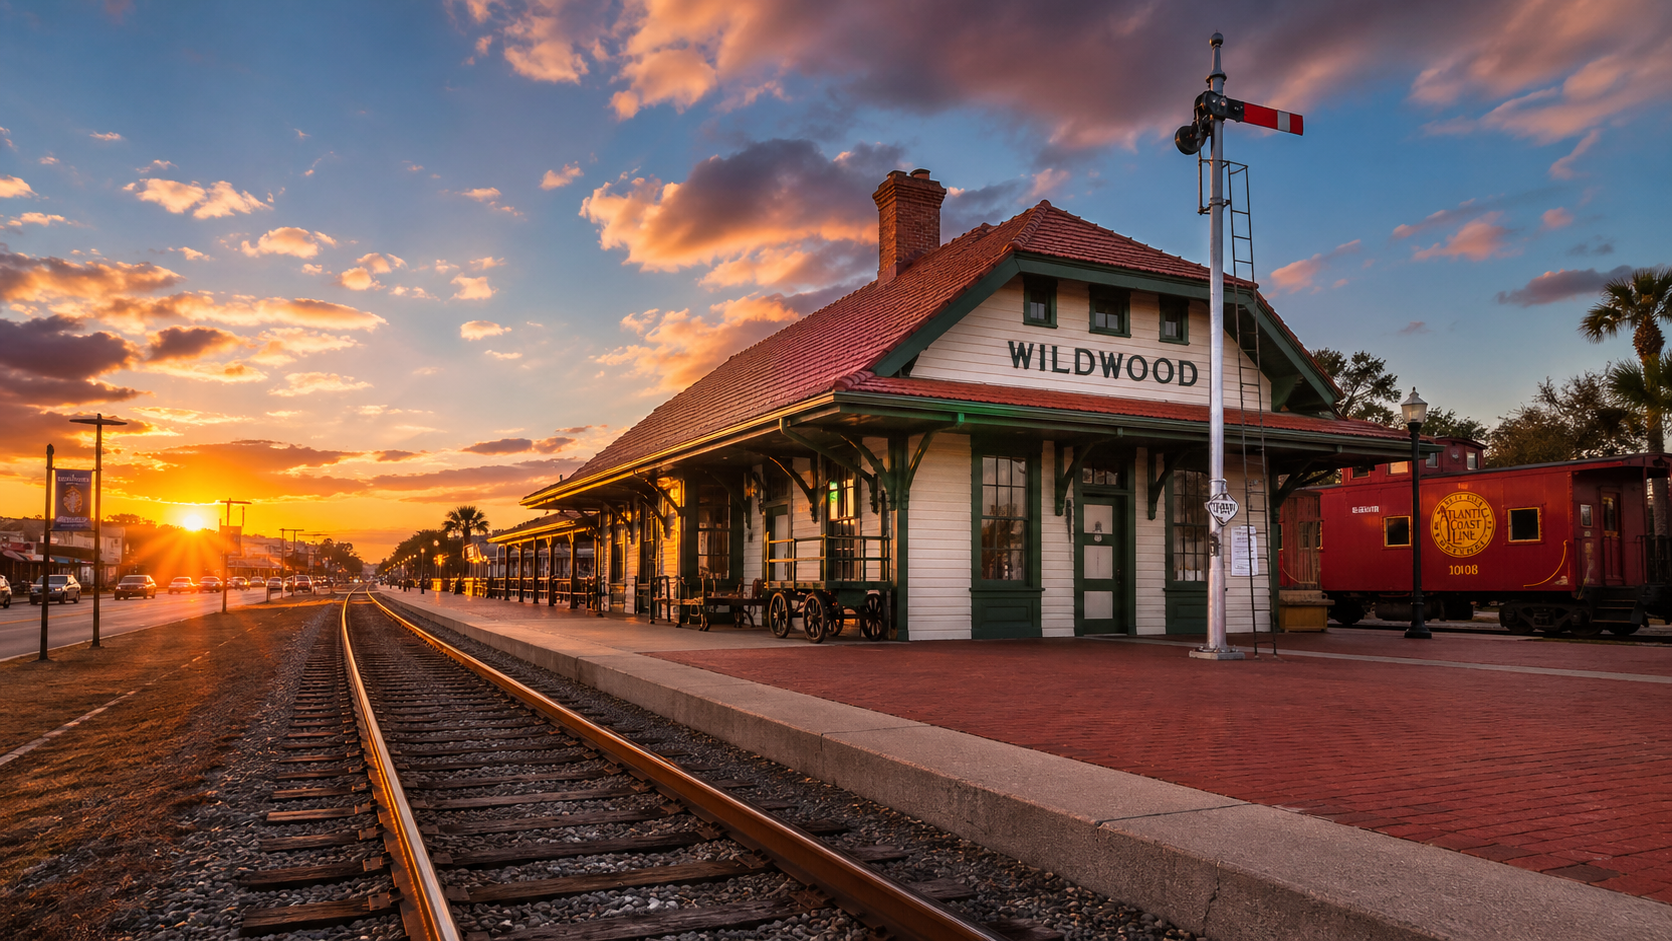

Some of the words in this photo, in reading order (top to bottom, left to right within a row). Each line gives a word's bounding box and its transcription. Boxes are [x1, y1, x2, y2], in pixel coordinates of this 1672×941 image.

[1008, 340, 1198, 387] WILDWOOD
[1450, 519, 1482, 530] COAST
[1452, 529, 1477, 545] LINE
[1449, 564, 1478, 575] 10108
